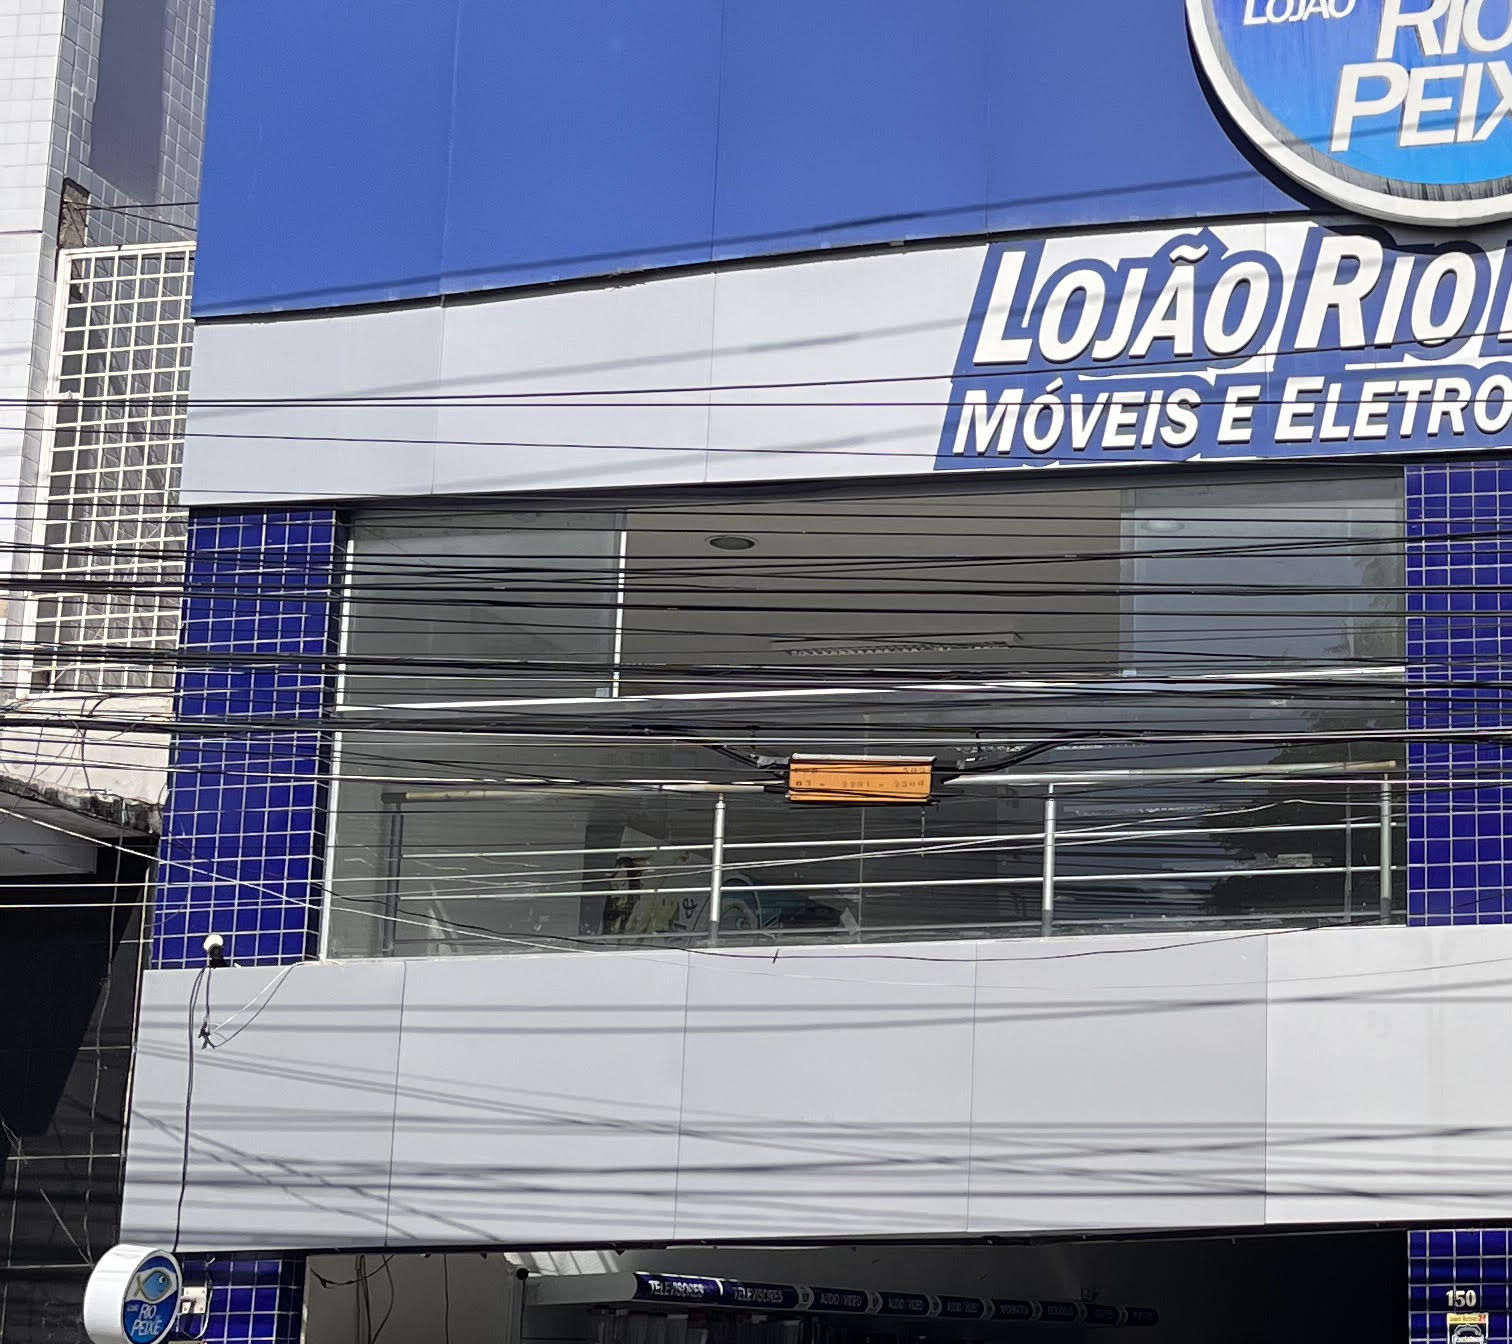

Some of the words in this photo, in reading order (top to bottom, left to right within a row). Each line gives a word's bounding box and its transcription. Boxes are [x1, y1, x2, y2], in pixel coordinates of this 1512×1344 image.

[972, 243, 1272, 367] LOJÃO
[1293, 234, 1477, 353] RIO
[952, 375, 1201, 455] MÓVEIS
[1217, 384, 1261, 444] E
[648, 1279, 705, 1299] TELEVISORES
[1446, 1289, 1477, 1307] 150
[138, 1304, 158, 1321] RIO
[130, 1319, 163, 1337] PEIXE
